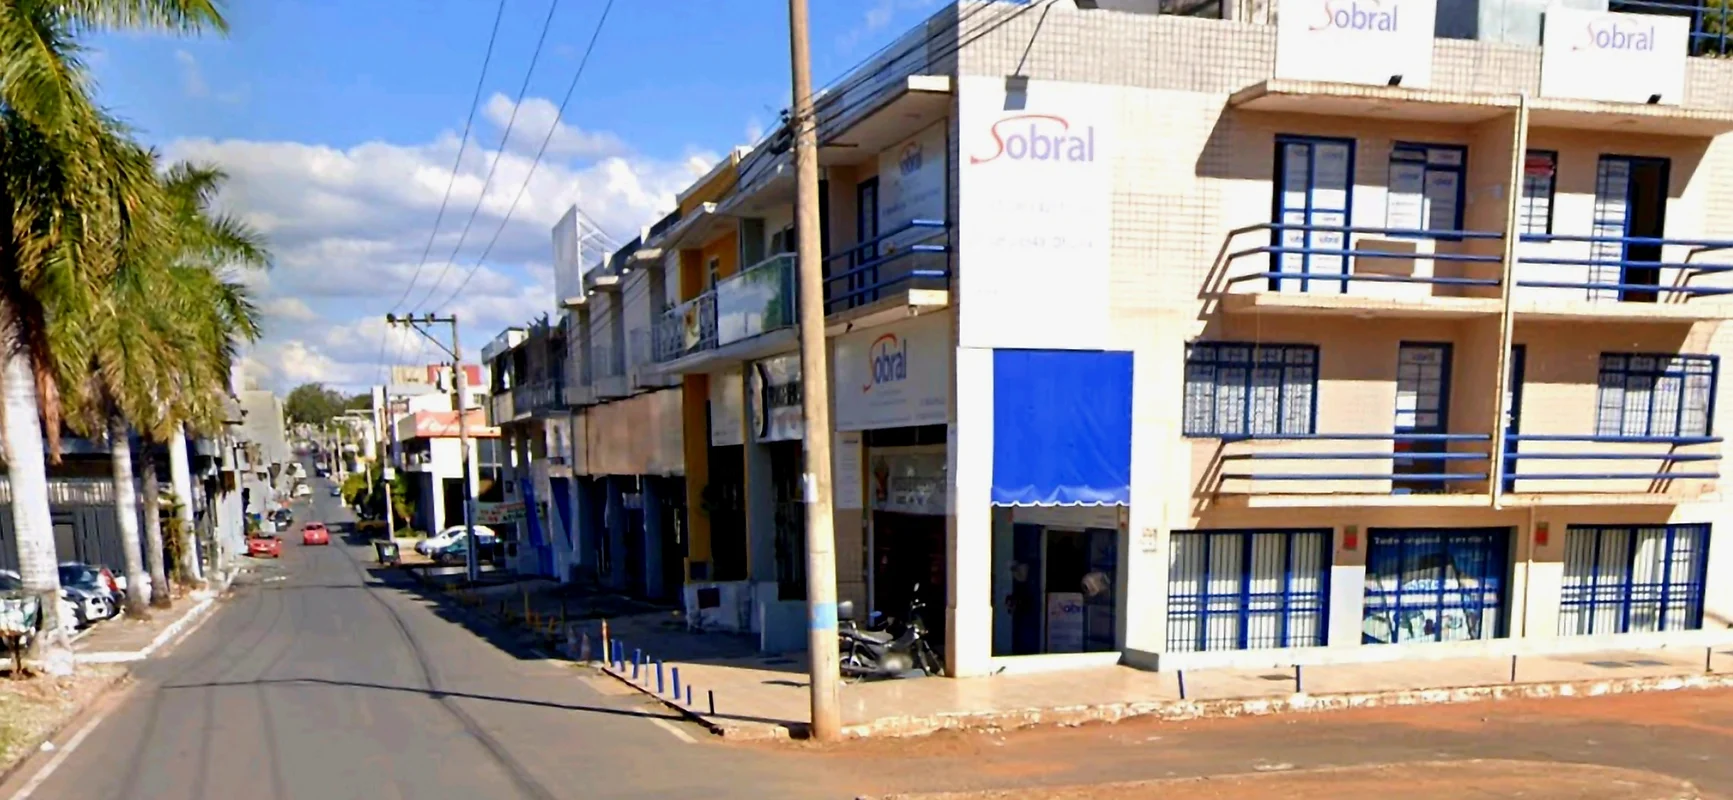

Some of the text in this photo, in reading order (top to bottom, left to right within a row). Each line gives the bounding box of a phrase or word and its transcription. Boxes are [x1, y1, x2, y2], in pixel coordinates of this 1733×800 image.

[1308, 0, 1399, 32] Sobral
[1572, 17, 1655, 51] Sobral
[970, 114, 1094, 165] Sobral
[863, 332, 907, 394] Sobral
